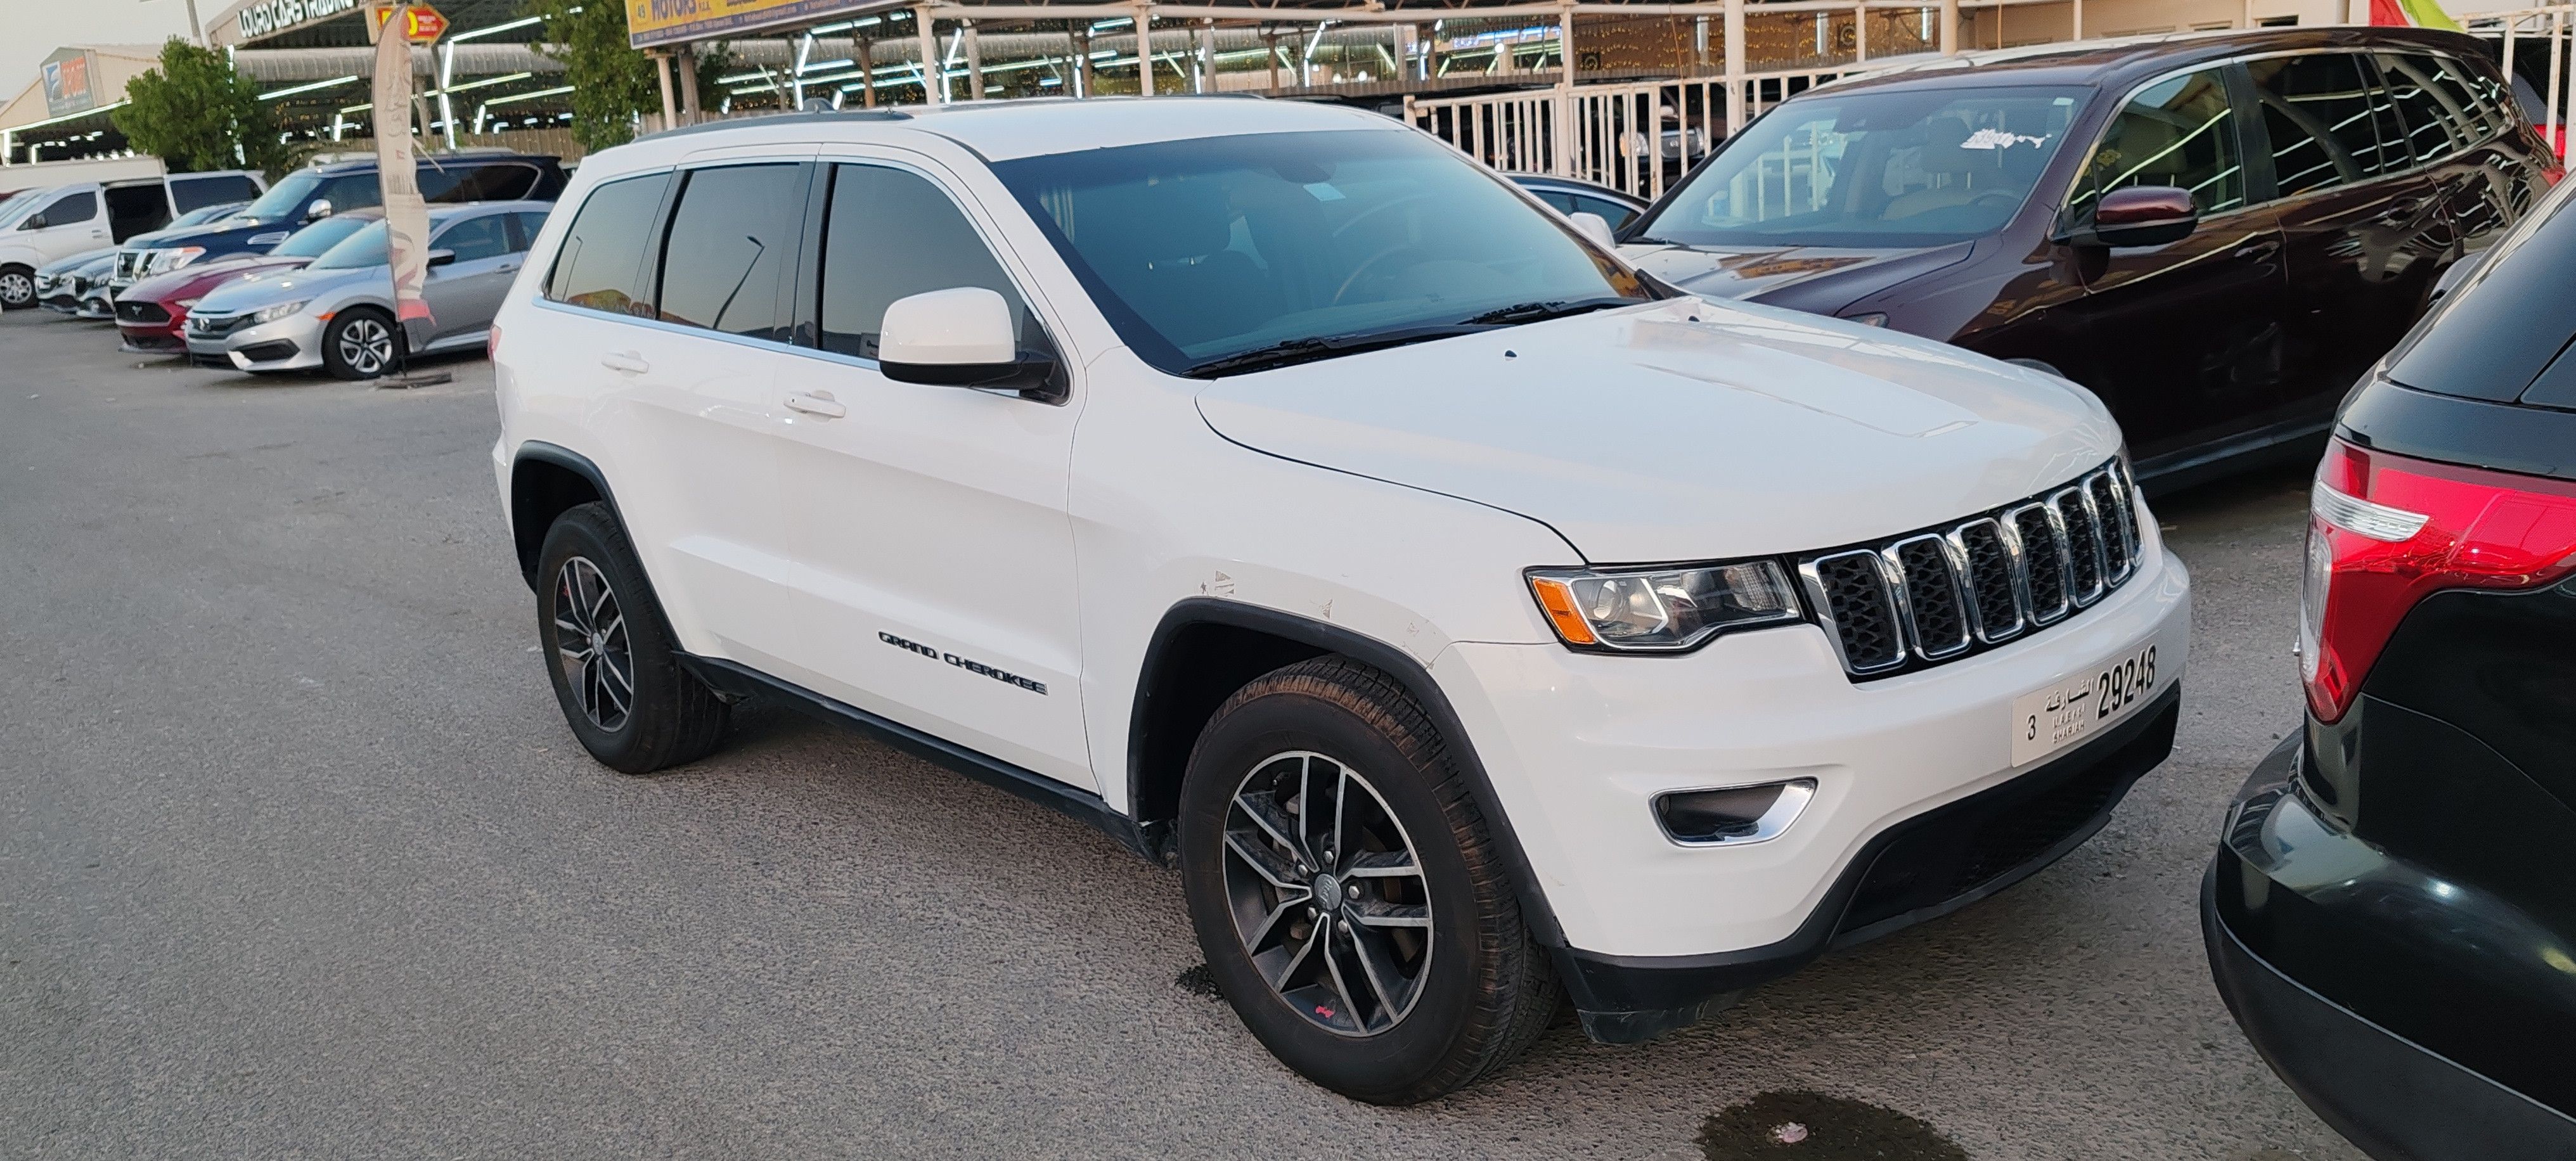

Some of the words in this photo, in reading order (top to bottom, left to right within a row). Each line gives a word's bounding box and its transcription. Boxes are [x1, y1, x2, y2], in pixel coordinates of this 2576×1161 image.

[878, 631, 939, 660] GRAND
[943, 653, 1048, 696] CHEROKEE
[2045, 677, 2094, 712] الشارقة
[2097, 645, 2156, 720] 29248
[2026, 714, 2036, 741] 3
[2052, 719, 2085, 744] SHARJAH
